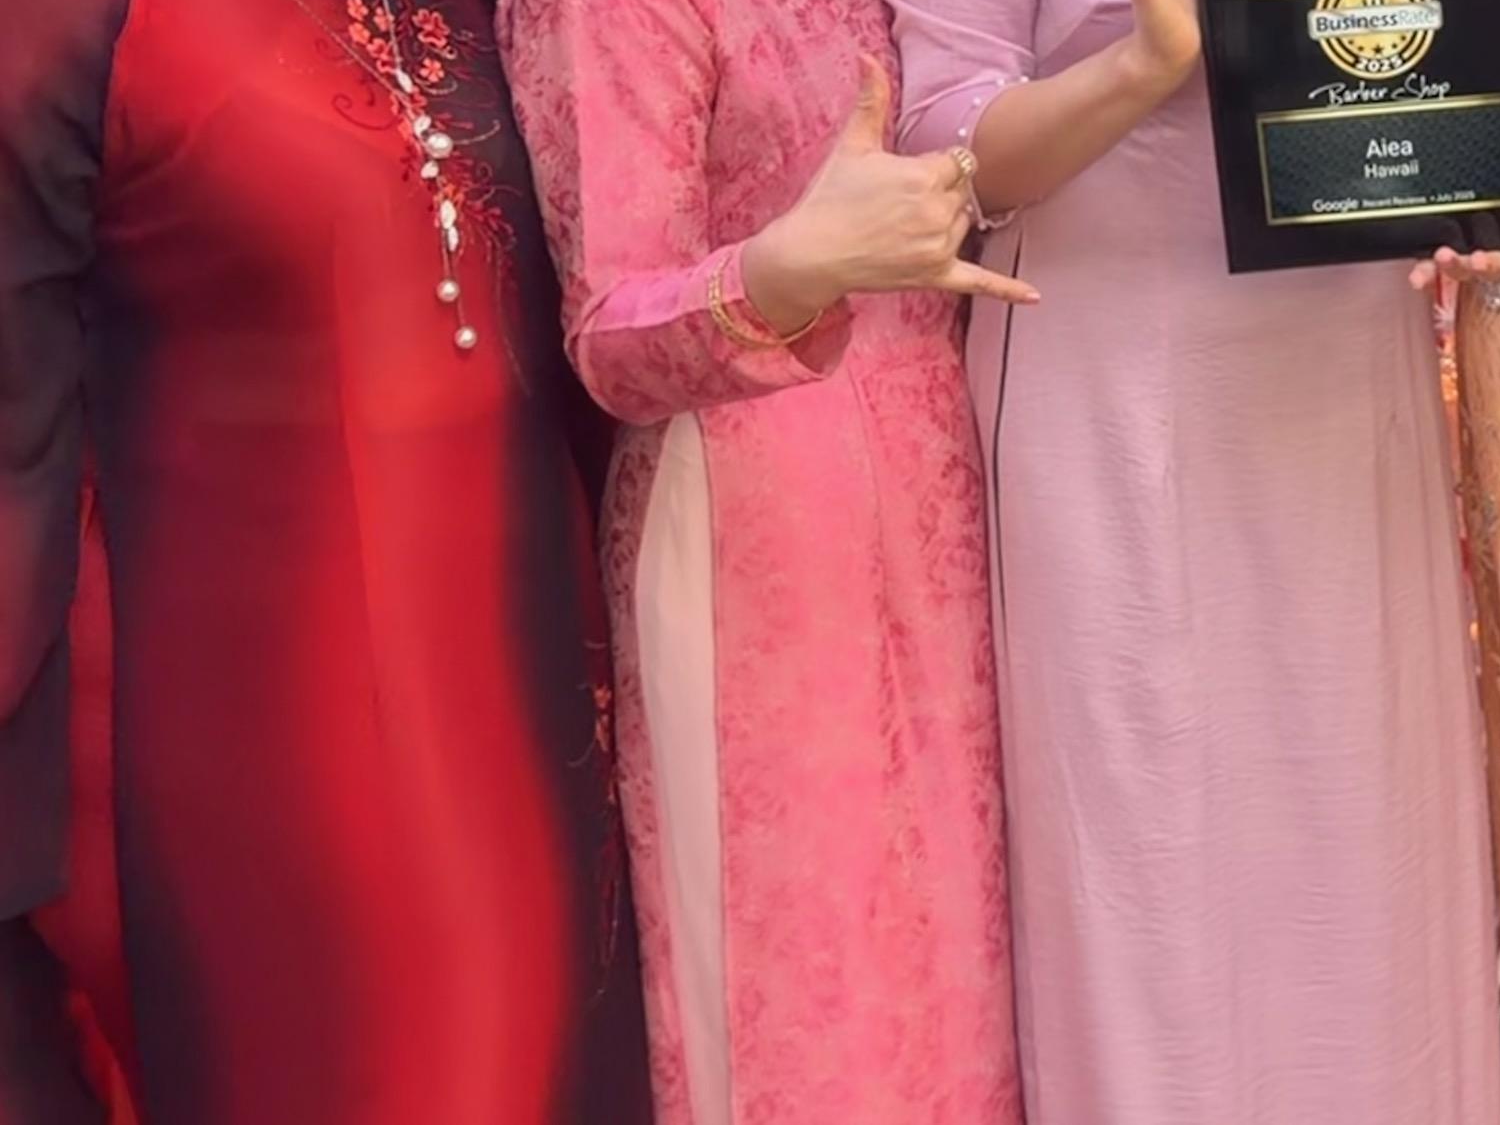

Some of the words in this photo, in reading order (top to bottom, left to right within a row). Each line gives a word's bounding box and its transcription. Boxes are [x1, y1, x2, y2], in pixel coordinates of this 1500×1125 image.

[1356, 56, 1403, 72] 2025
[1308, 81, 1388, 107] Barber
[1391, 73, 1451, 100] Shop
[1366, 137, 1414, 158] Aiea
[1364, 160, 1420, 179] Hawaii
[1312, 197, 1359, 213] Google
